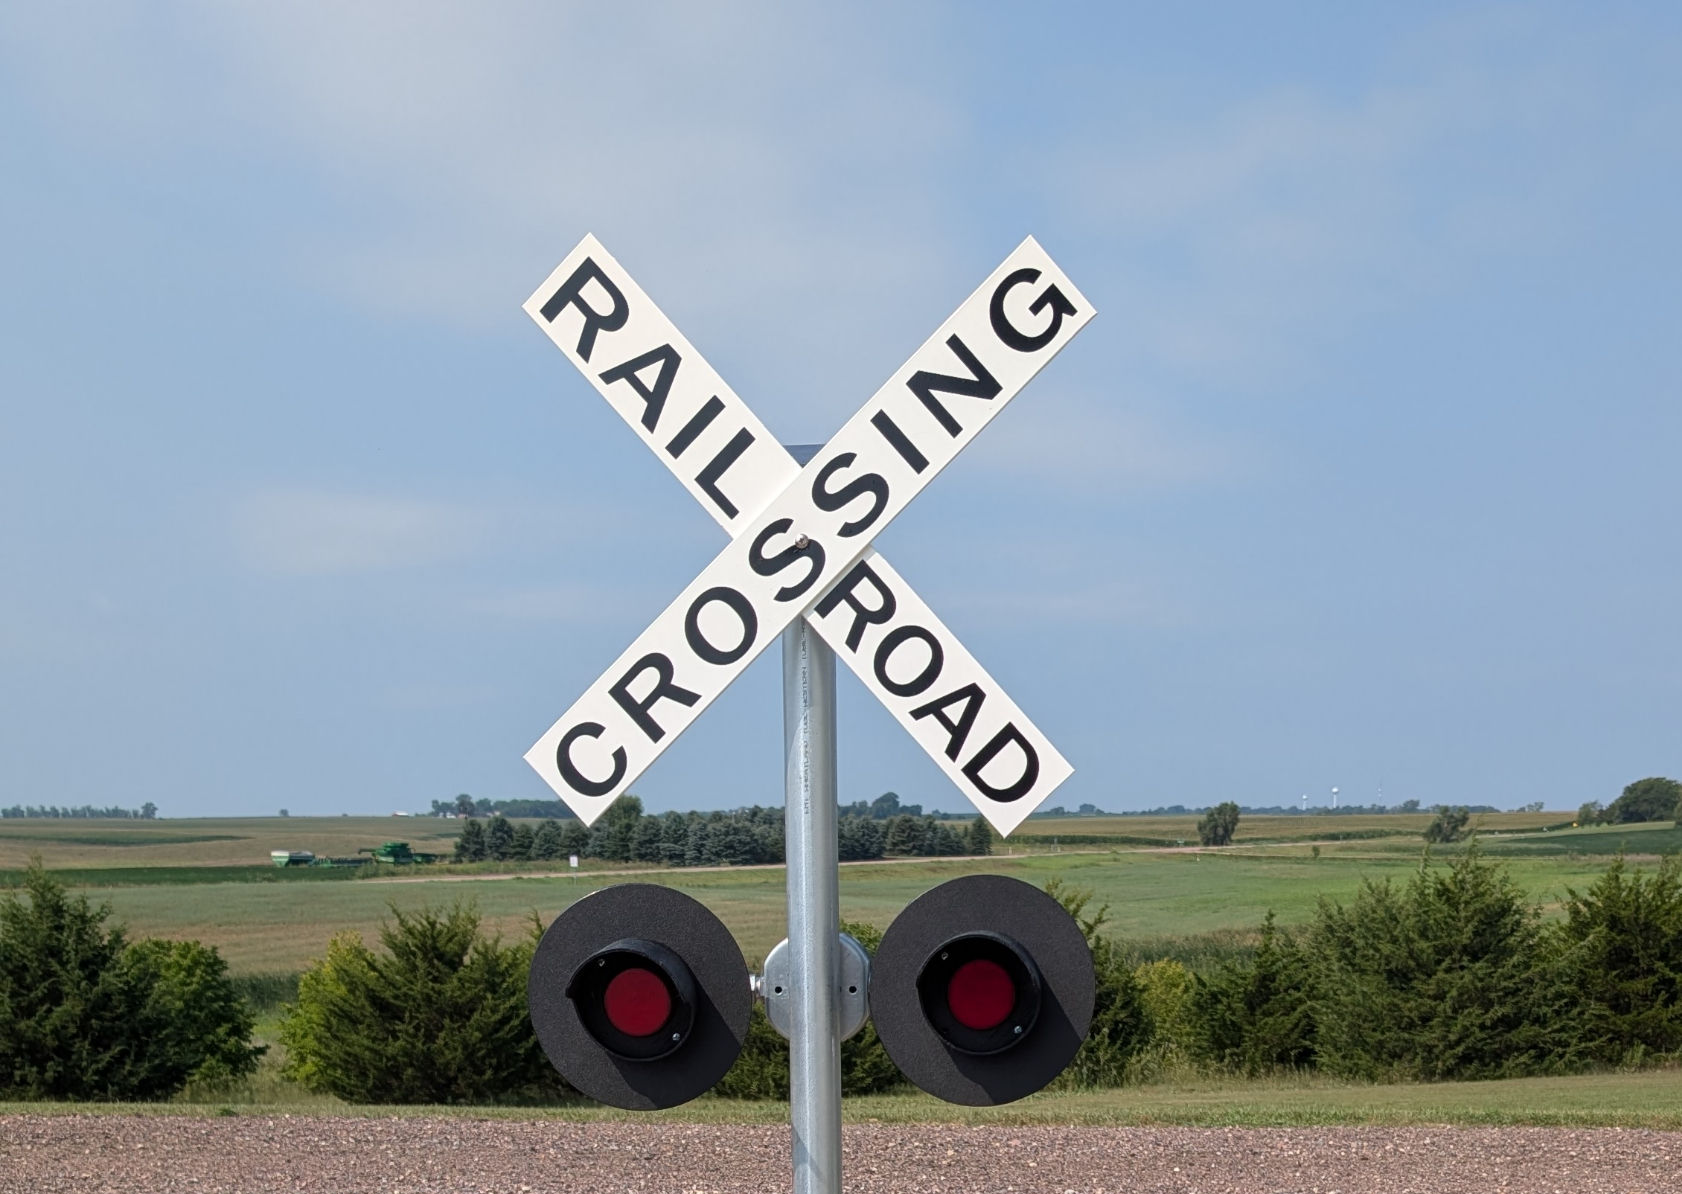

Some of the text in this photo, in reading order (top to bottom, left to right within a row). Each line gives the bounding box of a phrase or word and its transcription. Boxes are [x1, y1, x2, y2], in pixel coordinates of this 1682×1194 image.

[540, 257, 1040, 803] RAIL ROAD
[556, 268, 1078, 797] CROSSING
